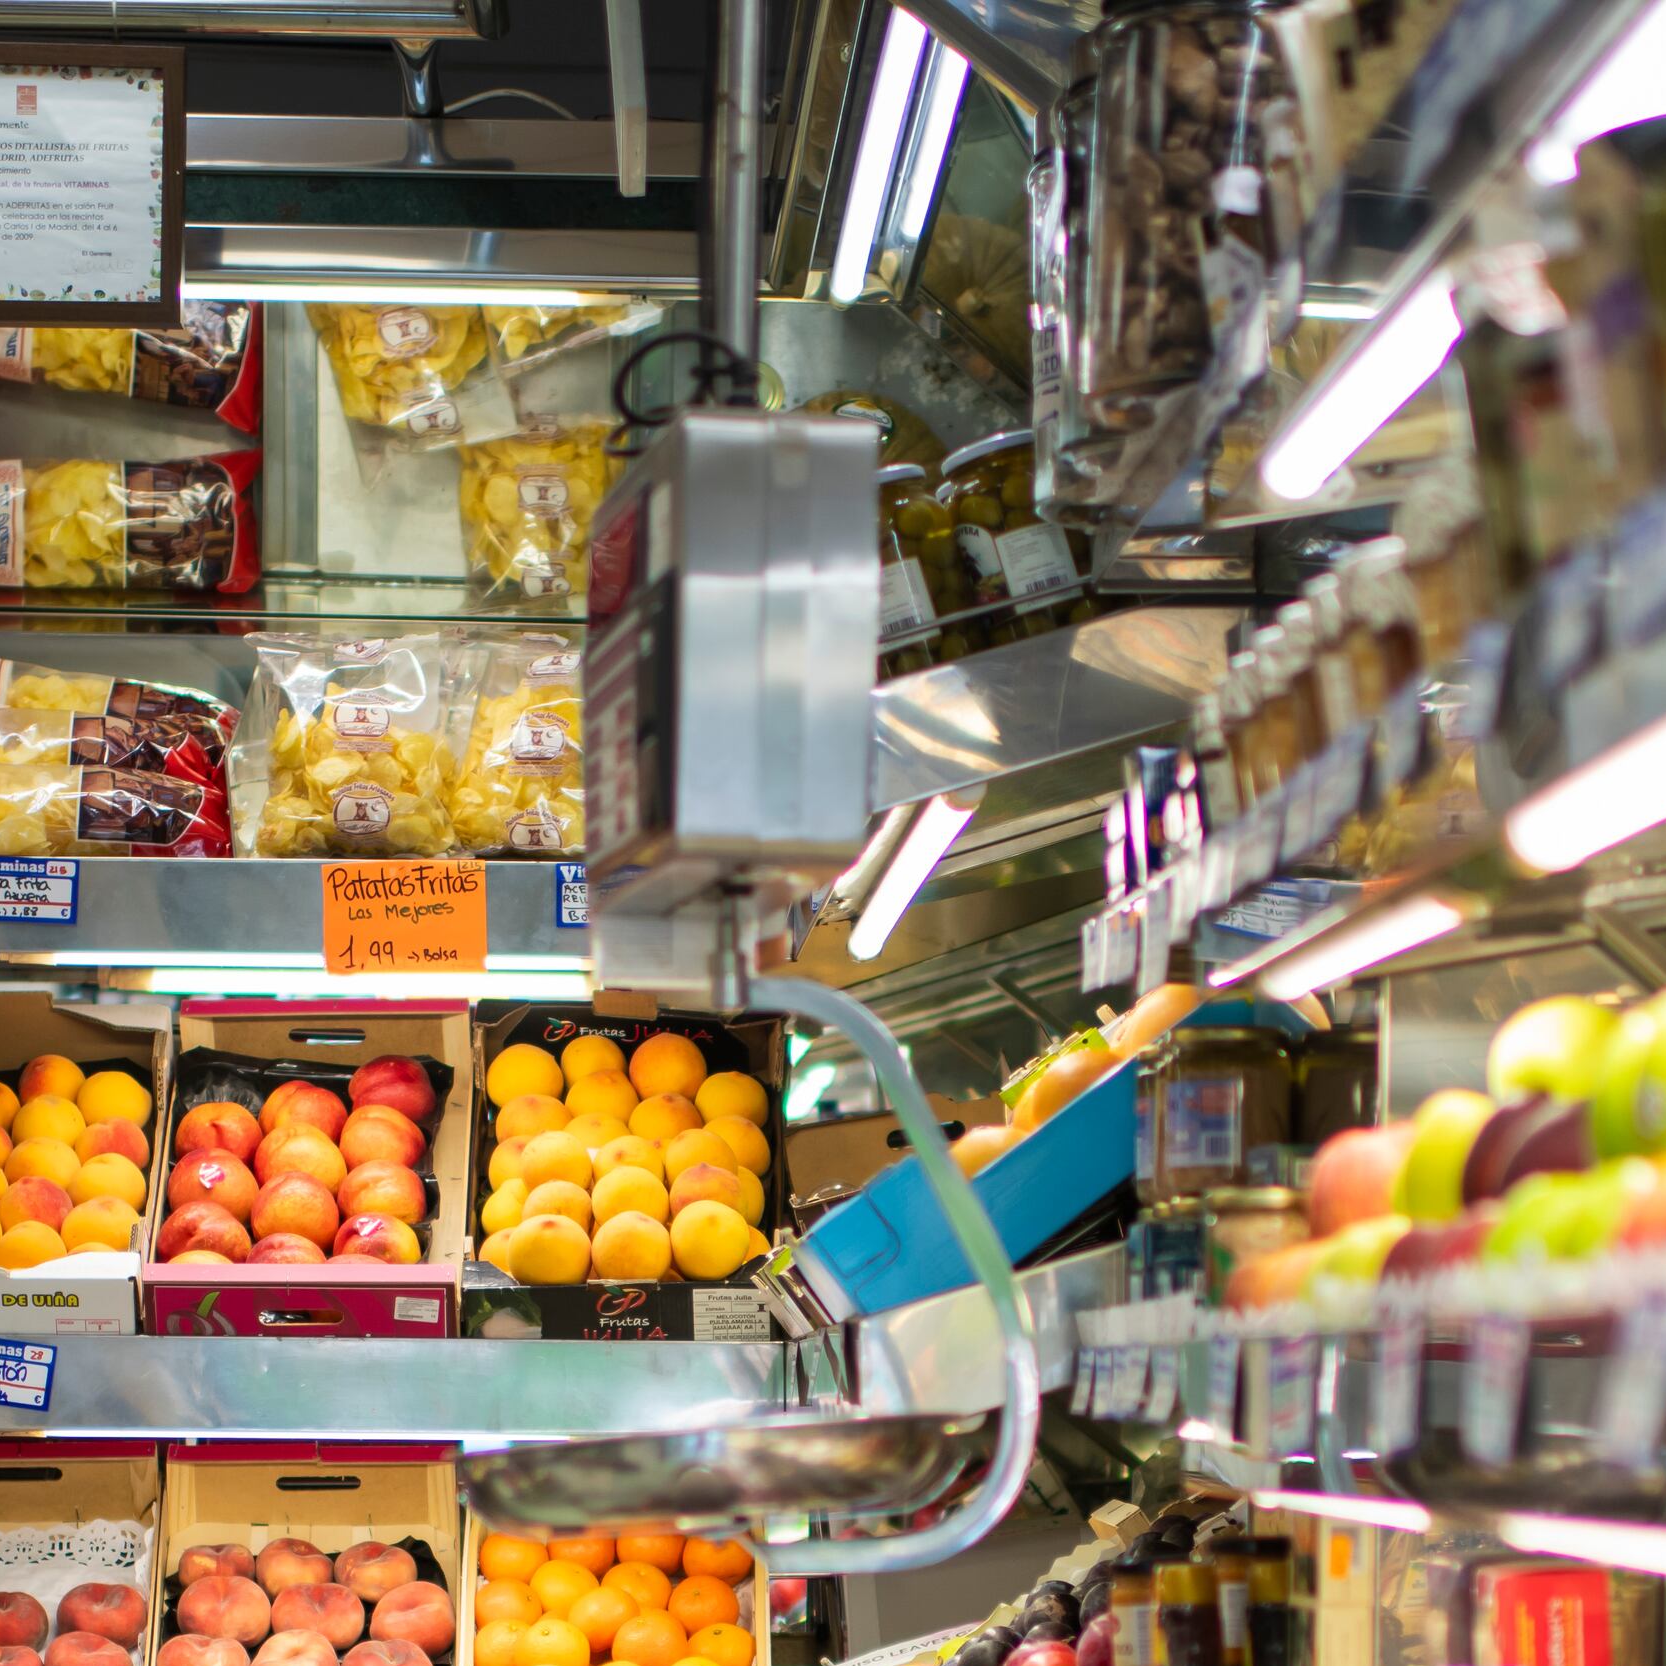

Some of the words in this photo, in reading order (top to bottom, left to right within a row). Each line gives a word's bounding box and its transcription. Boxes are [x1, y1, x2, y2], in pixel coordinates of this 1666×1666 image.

[14, 143, 76, 151] DETALLISTAS
[78, 143, 91, 151] DE
[93, 143, 129, 151] FRUTAS
[30, 154, 85, 162] ADEFRUTAS
[15, 876, 51, 891] Frita
[327, 868, 415, 902] Patatas
[412, 865, 478, 896] Fritas
[349, 906, 373, 921] Las
[385, 902, 455, 924] Mejores
[339, 935, 395, 969] 1,99
[423, 947, 458, 963] Bolsa
[580, 1025, 626, 1038] Frutas
[2, 1294, 29, 1307] DE
[32, 1292, 79, 1307] VIÑA
[599, 1315, 650, 1329] Frutas
[30, 1350, 44, 1361] 28
[889, 1635, 951, 1657] LEAVES
